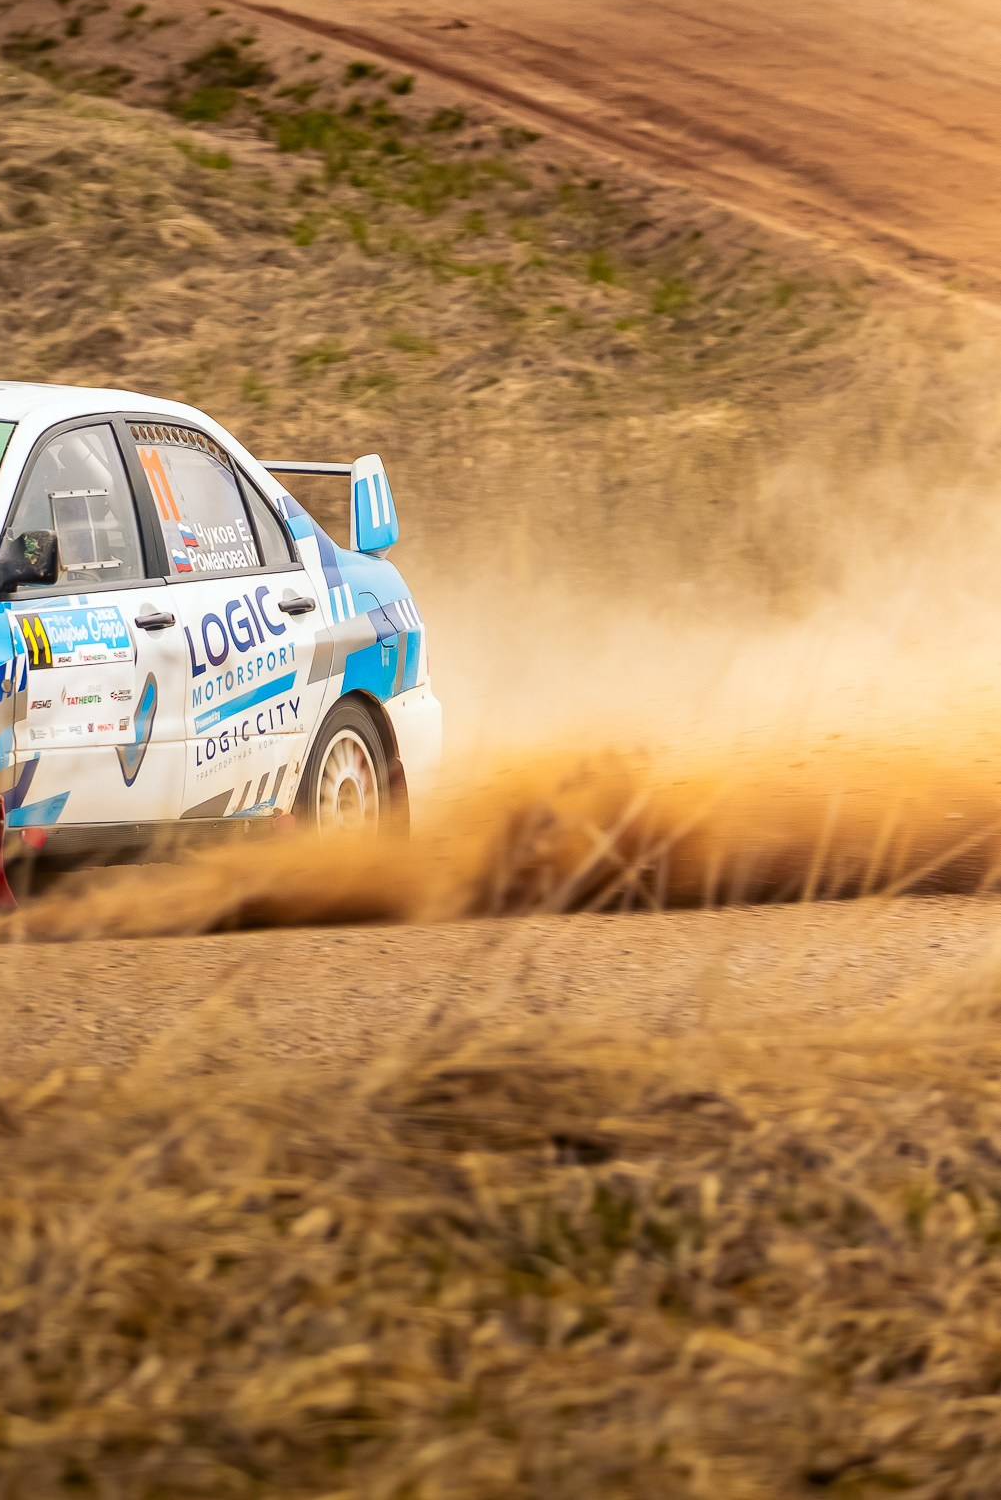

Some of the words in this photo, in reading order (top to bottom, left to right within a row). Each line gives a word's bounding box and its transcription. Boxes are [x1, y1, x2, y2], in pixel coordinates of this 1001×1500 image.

[140, 448, 181, 521] 11
[186, 547, 248, 572] Романова
[193, 522, 237, 551] Чуков
[22, 617, 52, 665] 11
[183, 585, 287, 678] LOGIC
[67, 695, 102, 706] ТАТНЕФТЬ
[192, 642, 296, 709] MOTORSPORT
[196, 720, 250, 767] LOGIC
[256, 696, 300, 735] CITY
